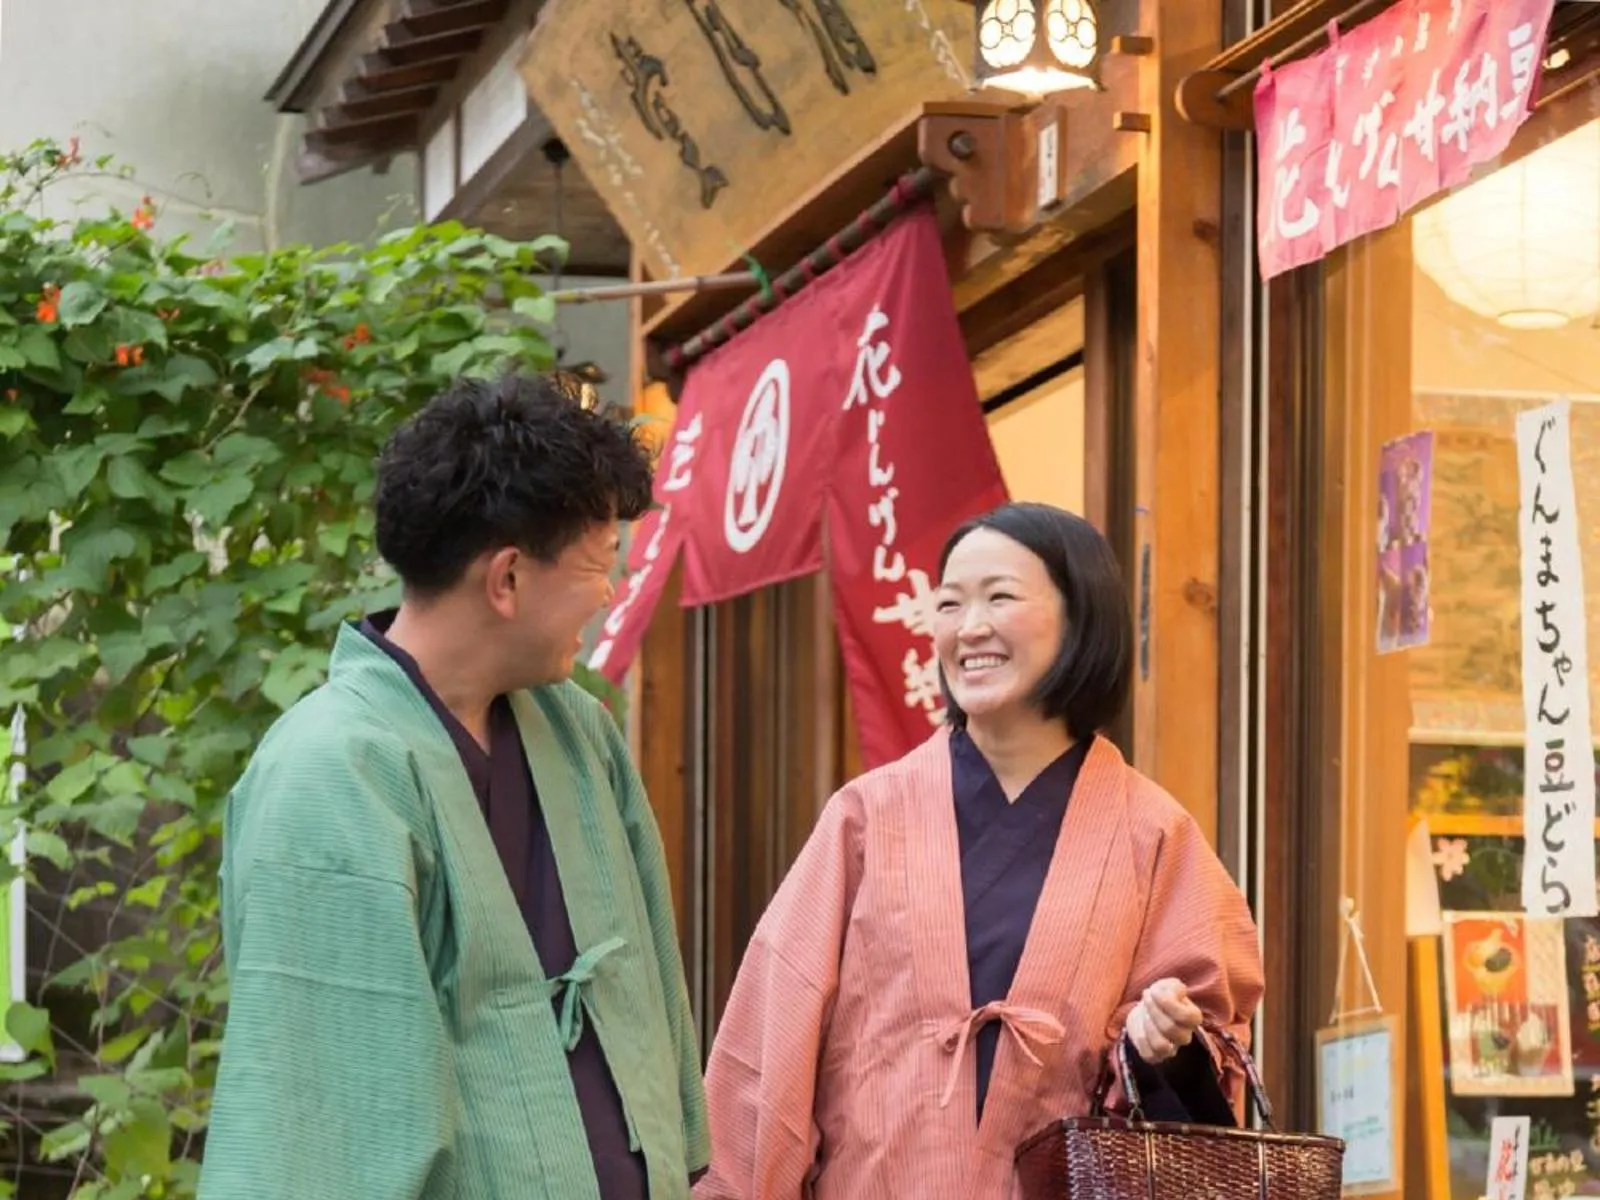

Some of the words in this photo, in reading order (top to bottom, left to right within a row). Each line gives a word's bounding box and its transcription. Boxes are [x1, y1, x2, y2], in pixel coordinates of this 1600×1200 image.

[1531, 417, 1577, 914] ぐんまちゃん豆どら
